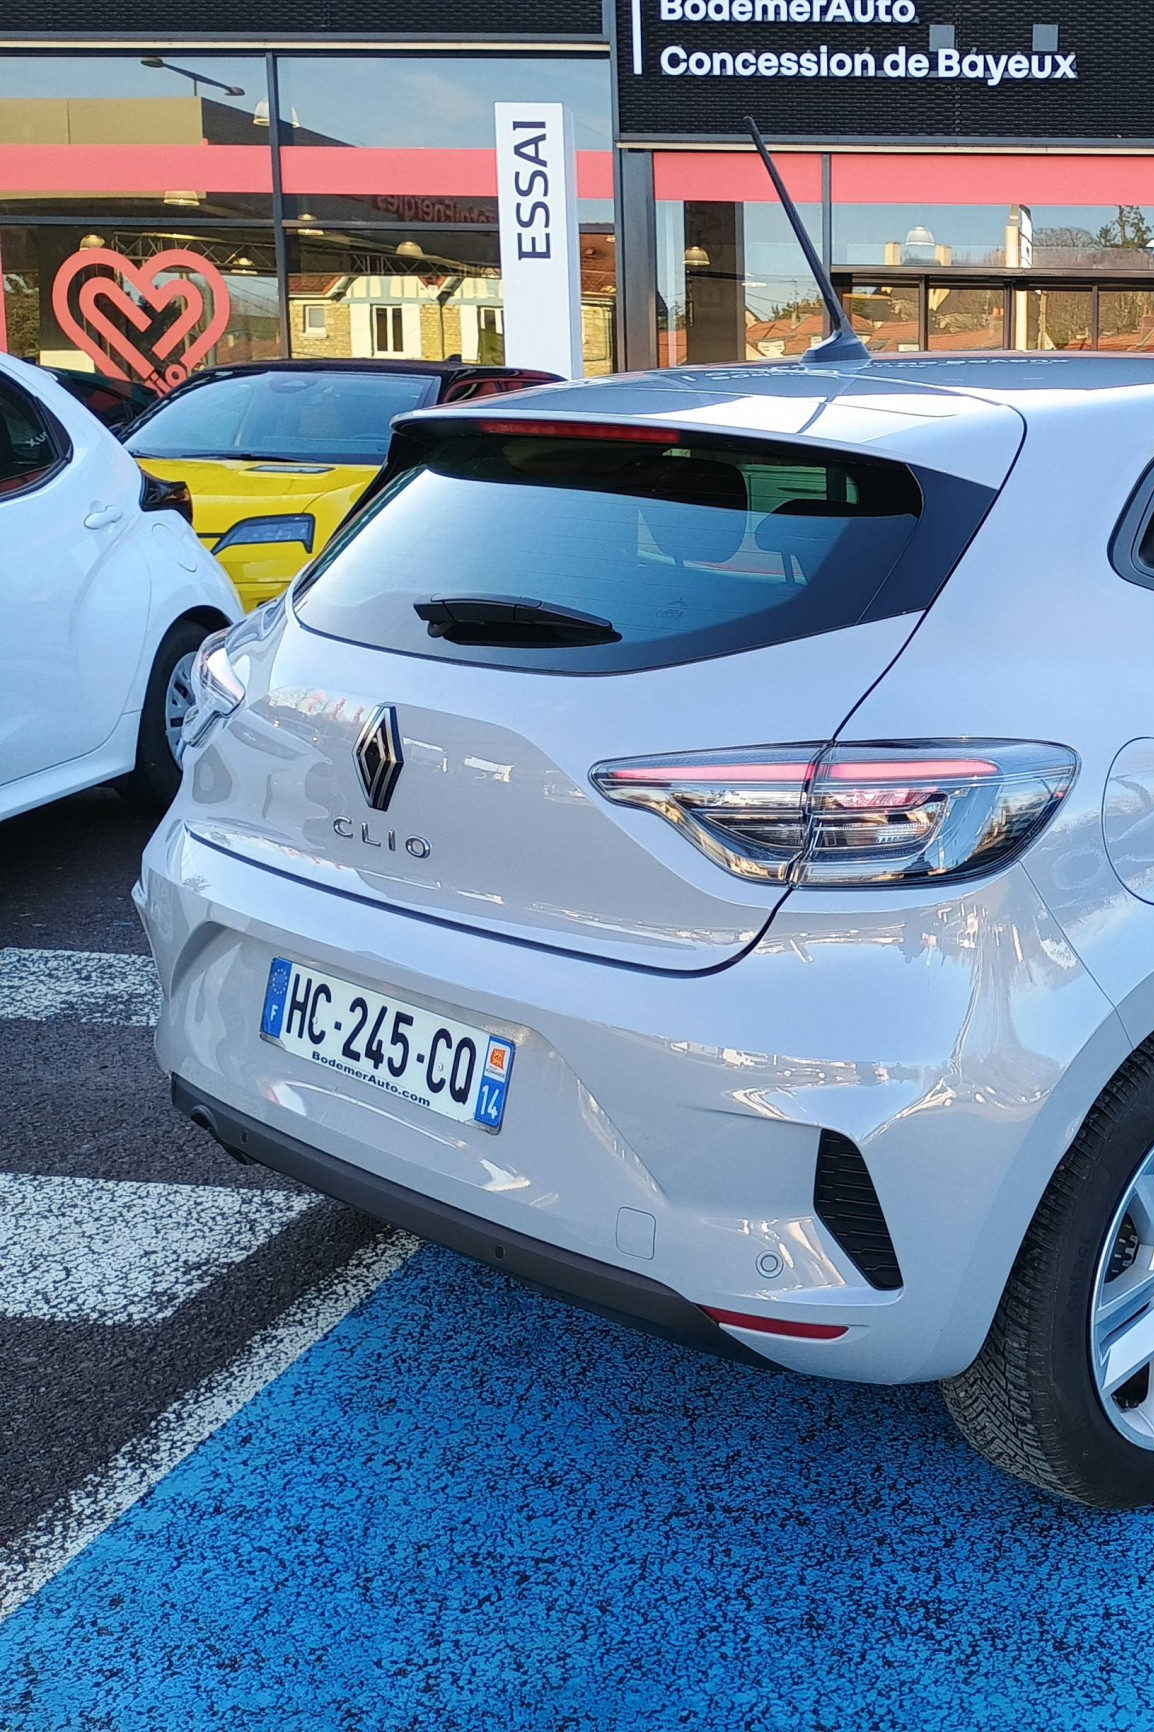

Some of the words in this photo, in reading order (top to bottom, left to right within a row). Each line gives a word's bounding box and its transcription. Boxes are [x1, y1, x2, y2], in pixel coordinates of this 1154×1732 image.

[660, 0, 917, 22] BodemerAuto
[660, 45, 876, 76] Concession
[883, 47, 929, 77] de
[937, 50, 1077, 85] Bayeux
[512, 121, 551, 261] ESSAI
[333, 816, 431, 859] CLIO
[269, 1004, 279, 1021] F
[286, 973, 477, 1105] HC-245-CQ
[311, 1050, 431, 1108] BodemerAuto.com
[480, 1084, 499, 1120] 14
